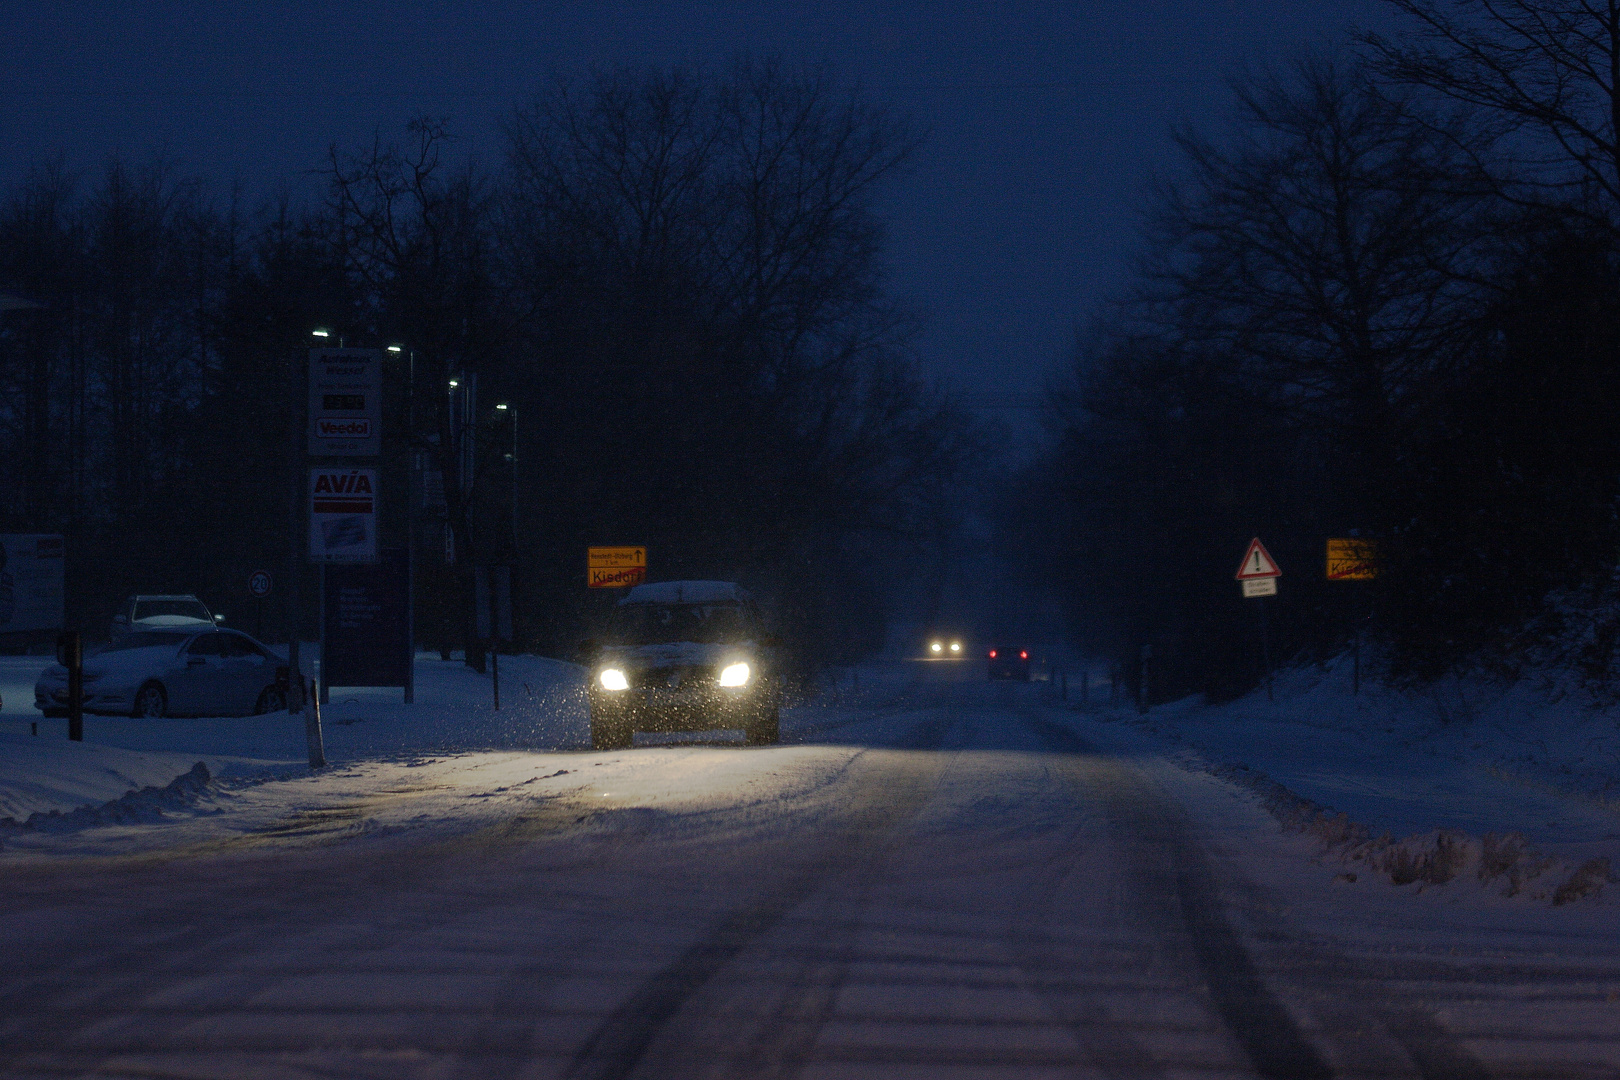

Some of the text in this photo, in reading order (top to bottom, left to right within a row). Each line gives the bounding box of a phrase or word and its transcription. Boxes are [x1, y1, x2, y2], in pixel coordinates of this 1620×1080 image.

[319, 421, 368, 434] Veedol
[593, 570, 642, 583] Kisdorf
[253, 577, 268, 590] 20
